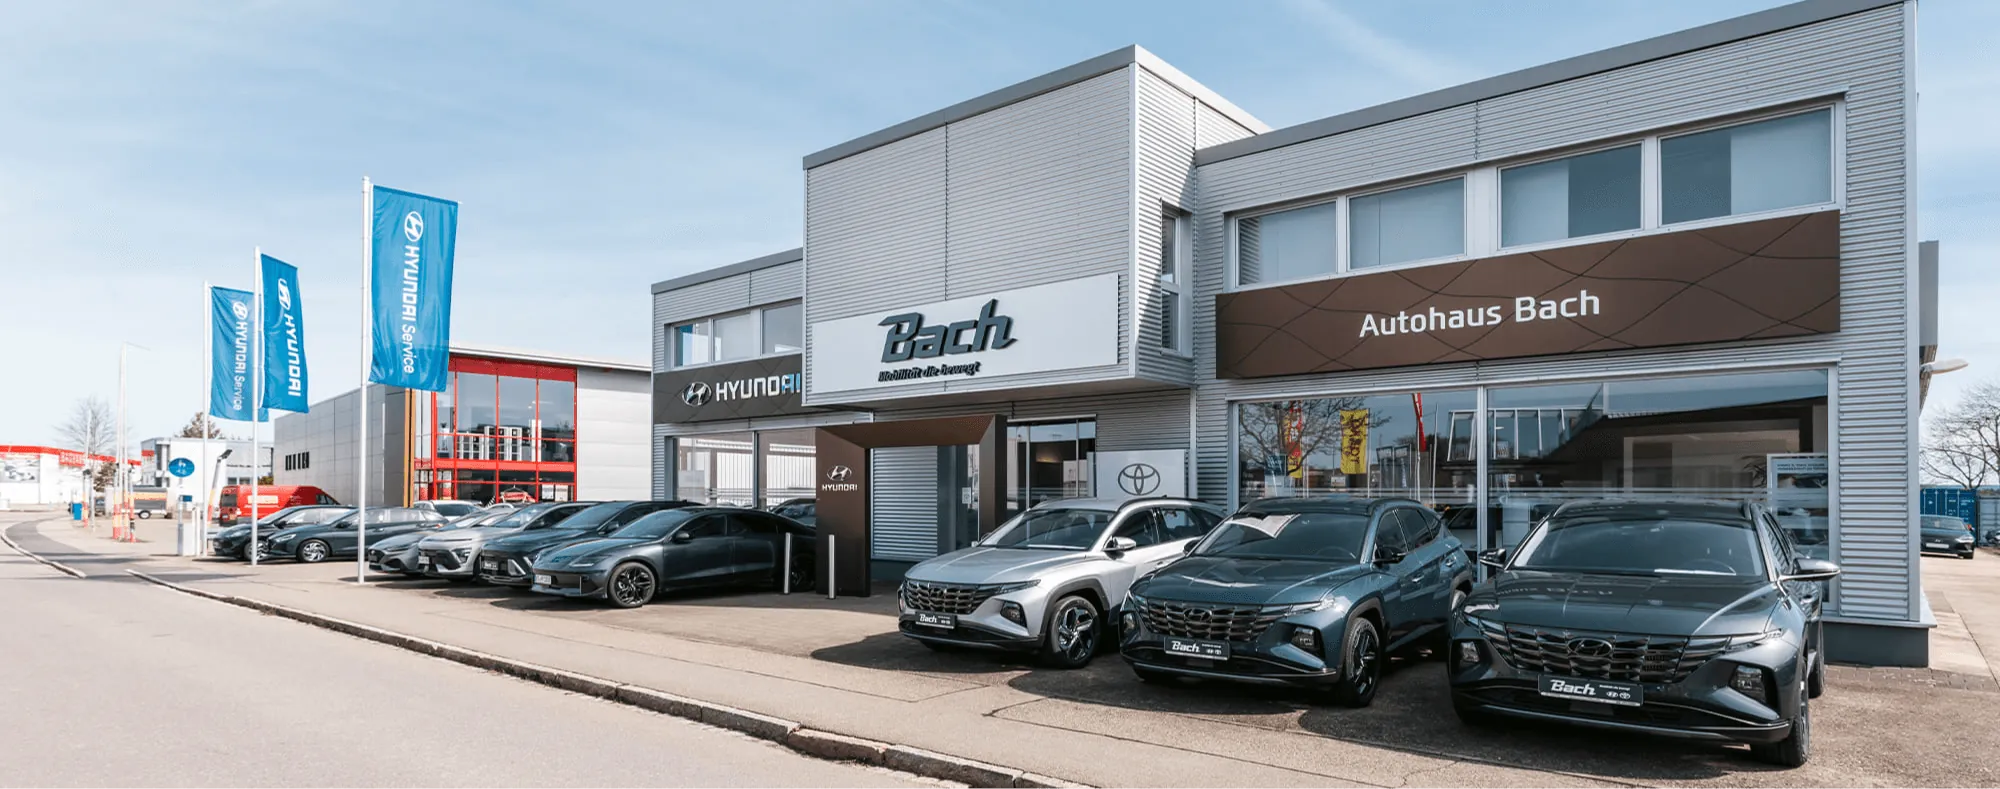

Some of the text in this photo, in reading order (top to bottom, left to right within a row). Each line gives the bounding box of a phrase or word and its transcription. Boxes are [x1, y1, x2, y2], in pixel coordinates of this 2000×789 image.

[401, 244, 420, 374] HYUNDAI Service
[1359, 290, 1600, 338] Autohaus Bach
[878, 298, 1018, 363] Bach
[233, 321, 248, 411] HYUNDAI Service
[284, 313, 302, 397] HYUNDAI
[922, 365, 940, 378] die
[940, 361, 981, 376] bewegt
[715, 372, 801, 402] HYUNDAI
[821, 484, 858, 492] HYUNDAI
[919, 613, 938, 624] Bach
[1171, 640, 1200, 653] Bach
[1550, 679, 1597, 696] Bach
